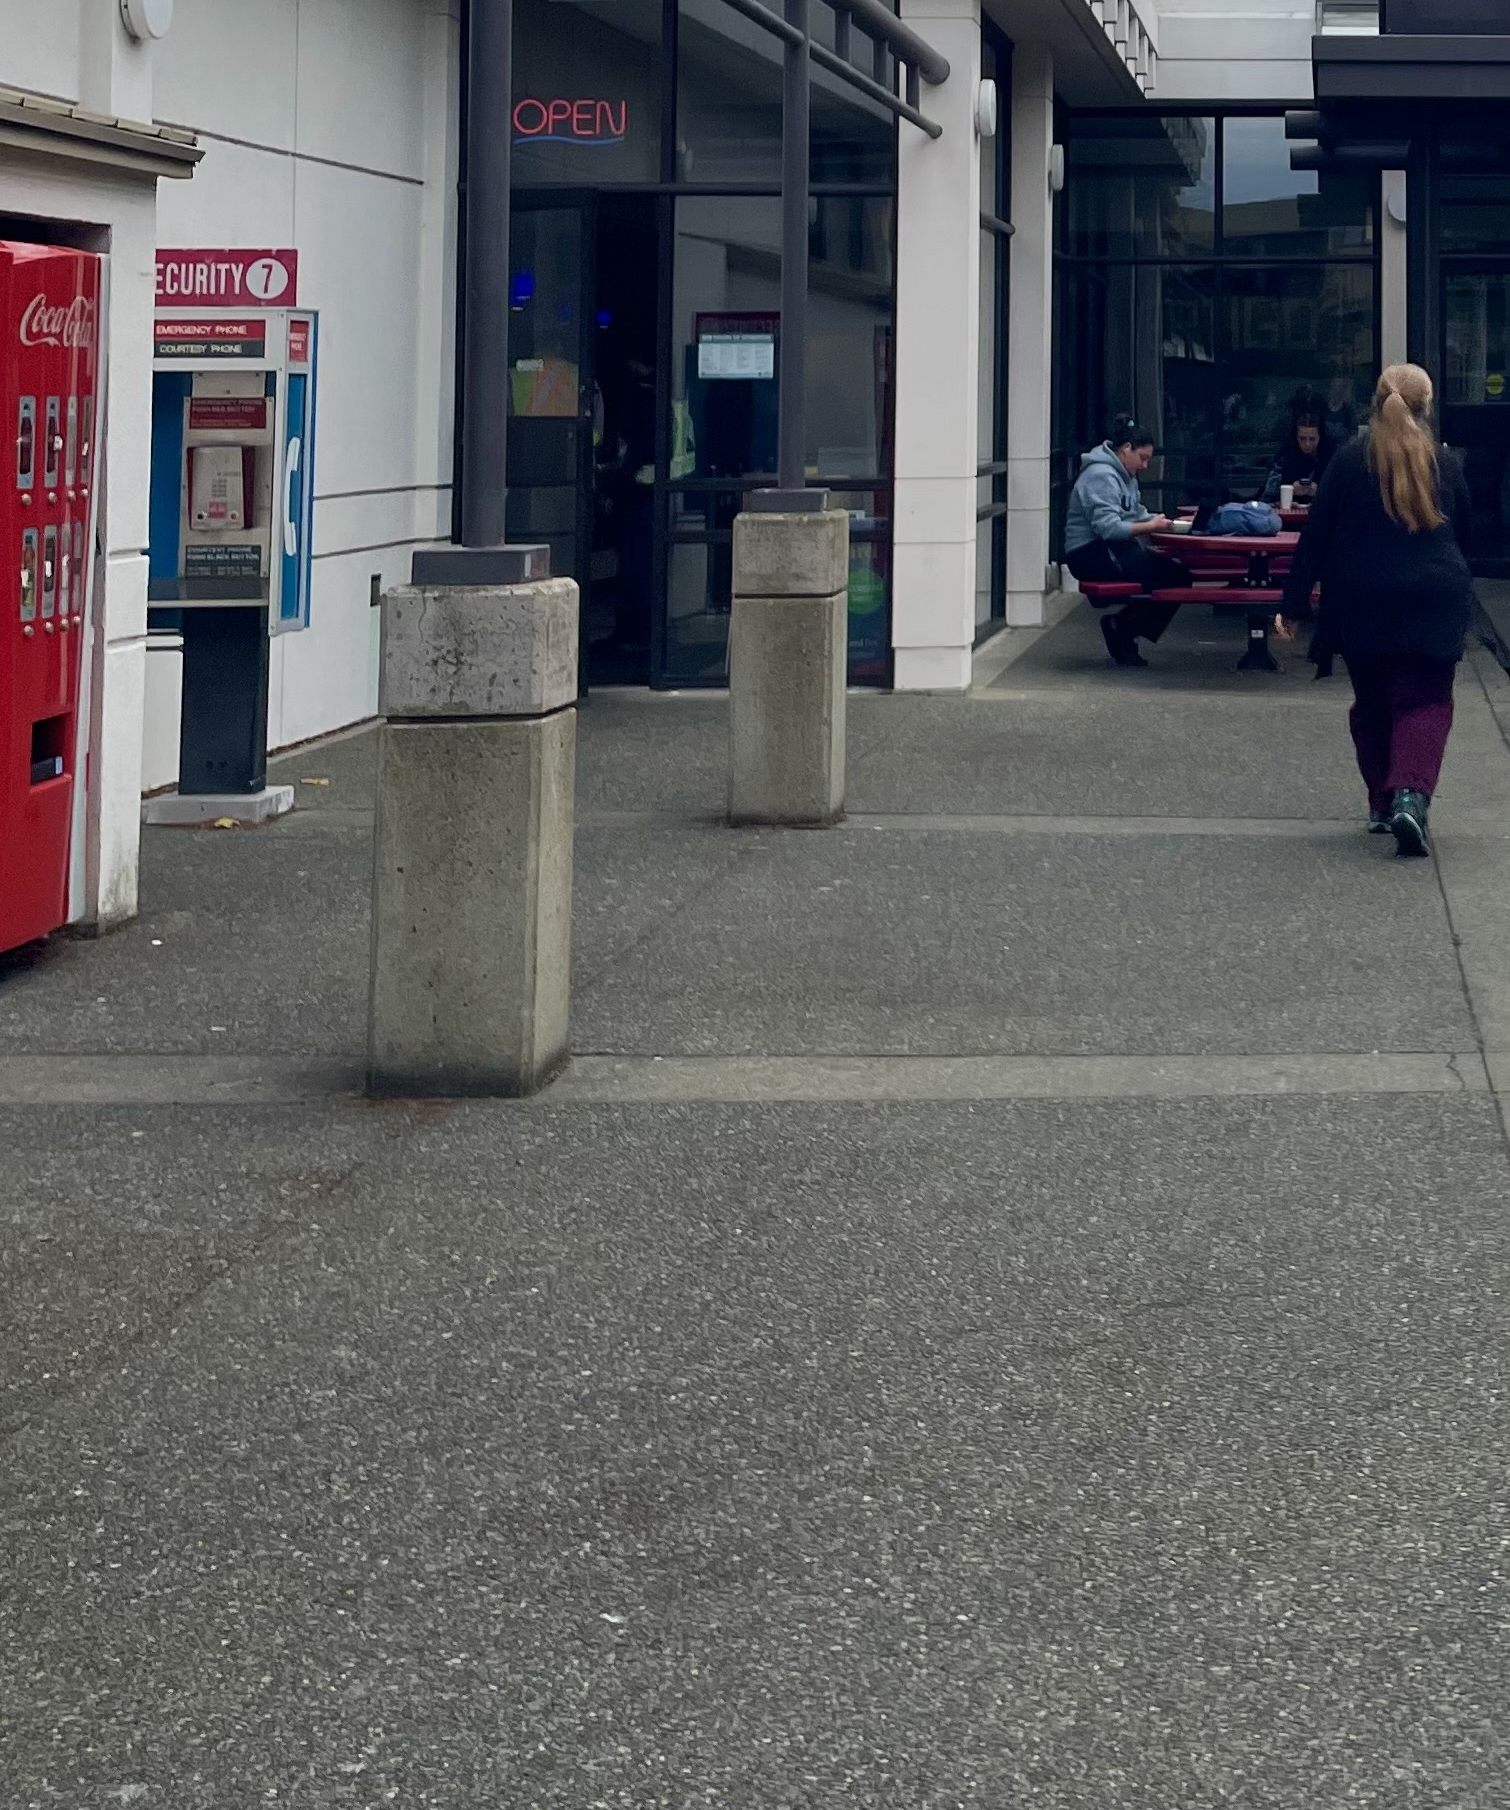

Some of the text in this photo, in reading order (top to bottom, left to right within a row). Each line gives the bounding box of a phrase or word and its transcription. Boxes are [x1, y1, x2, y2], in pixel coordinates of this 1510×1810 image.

[513, 98, 626, 135] OPEN
[154, 262, 274, 296] ECURITY 7
[156, 324, 248, 335] EMERGENCY PHONE
[160, 343, 242, 354] COURTESY PHONE
